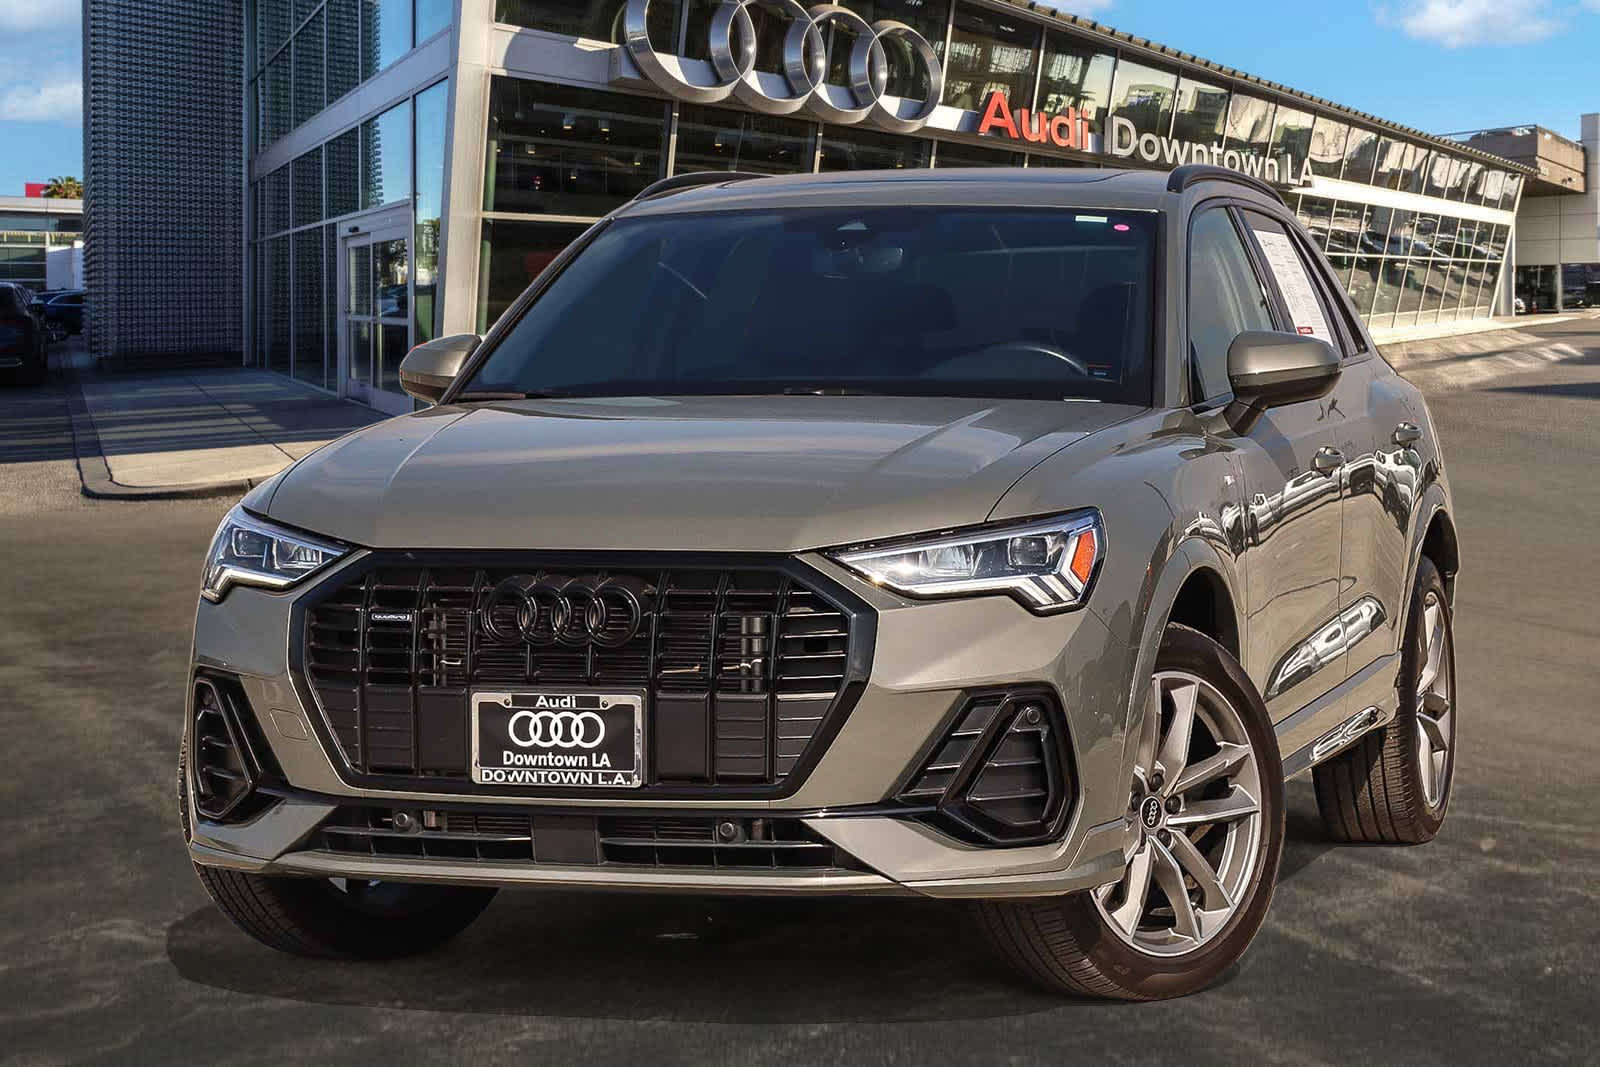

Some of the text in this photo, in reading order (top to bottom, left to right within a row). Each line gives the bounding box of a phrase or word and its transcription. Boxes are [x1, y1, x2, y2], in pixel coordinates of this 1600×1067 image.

[978, 91, 1316, 189] Audi Downtown LA
[535, 695, 577, 709] Audi
[502, 750, 612, 768] Downtown LA
[481, 769, 631, 786] DOWNTOWN L.A.
